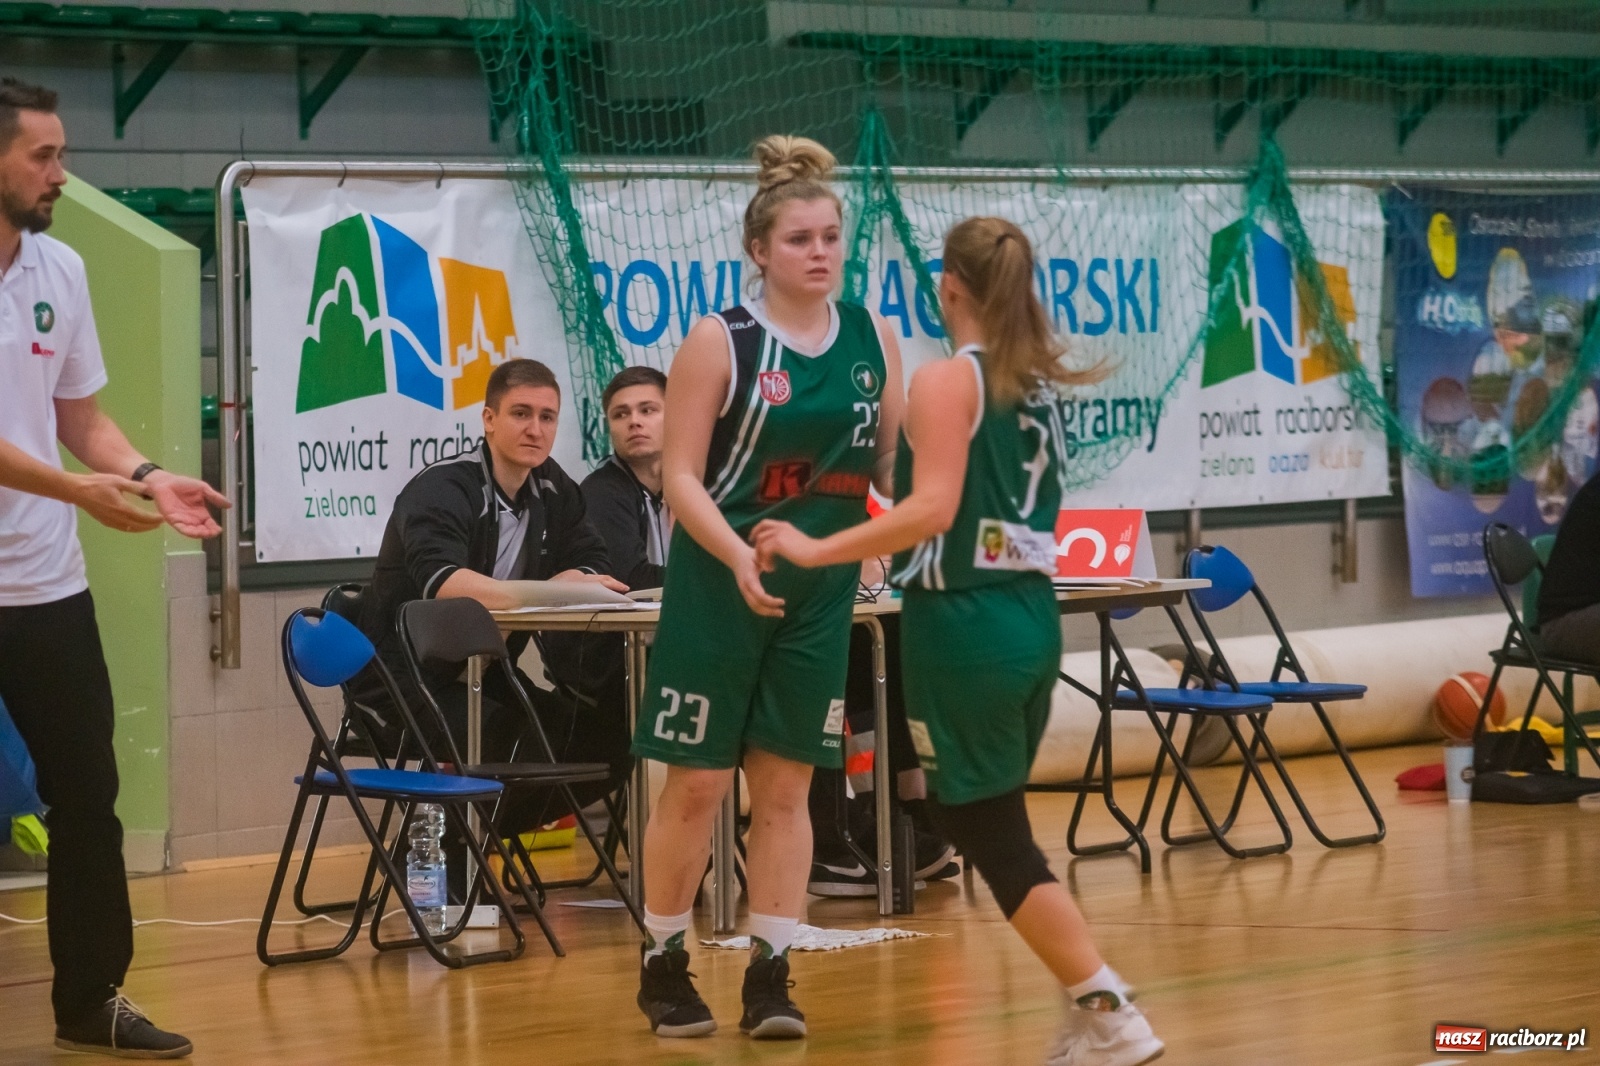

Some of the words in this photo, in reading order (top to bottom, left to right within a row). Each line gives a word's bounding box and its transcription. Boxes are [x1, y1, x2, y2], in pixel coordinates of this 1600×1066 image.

[588, 259, 742, 346] POWI
[1199, 397, 1262, 450] powiat
[298, 426, 389, 486] powiat
[304, 488, 377, 519] zielona
[653, 686, 710, 745] 23
